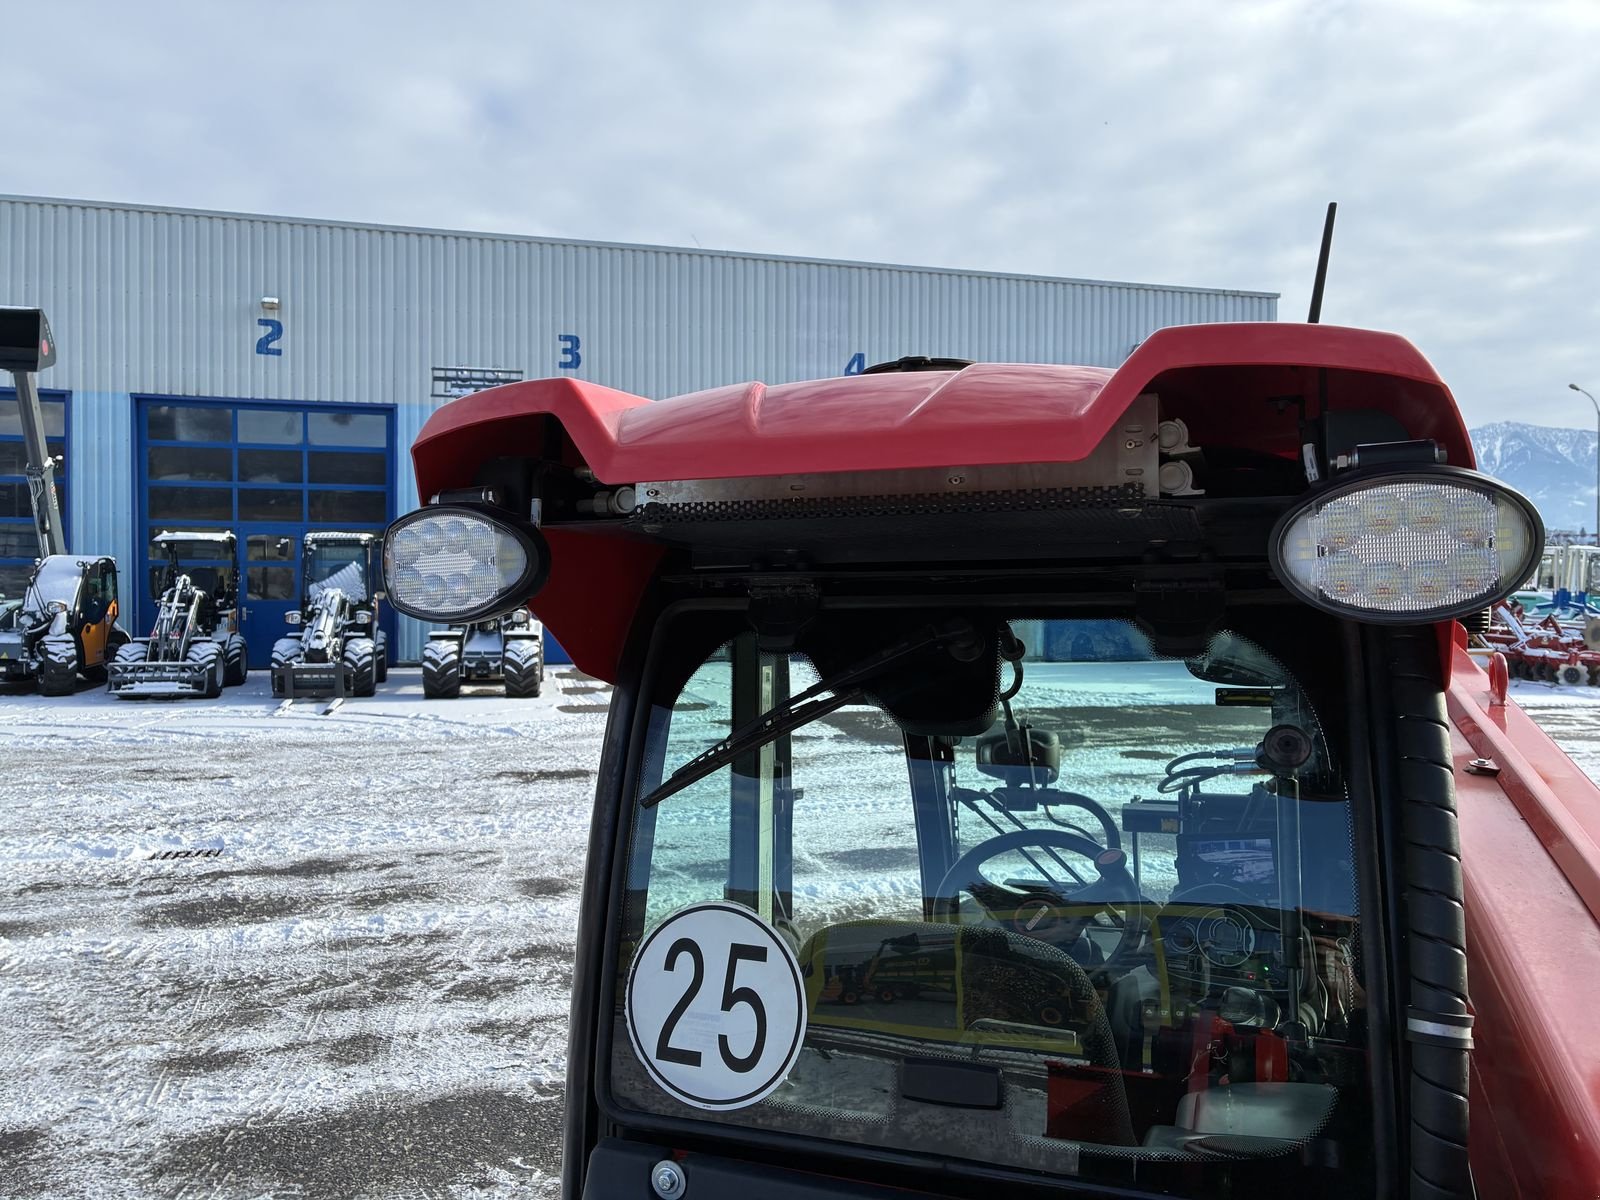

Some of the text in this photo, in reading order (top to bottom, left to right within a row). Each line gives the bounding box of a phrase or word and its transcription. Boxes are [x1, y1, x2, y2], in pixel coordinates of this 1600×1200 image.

[256, 318, 283, 356] 2
[558, 334, 581, 369] 3
[844, 352, 865, 376] 4
[655, 937, 768, 1074] 25
